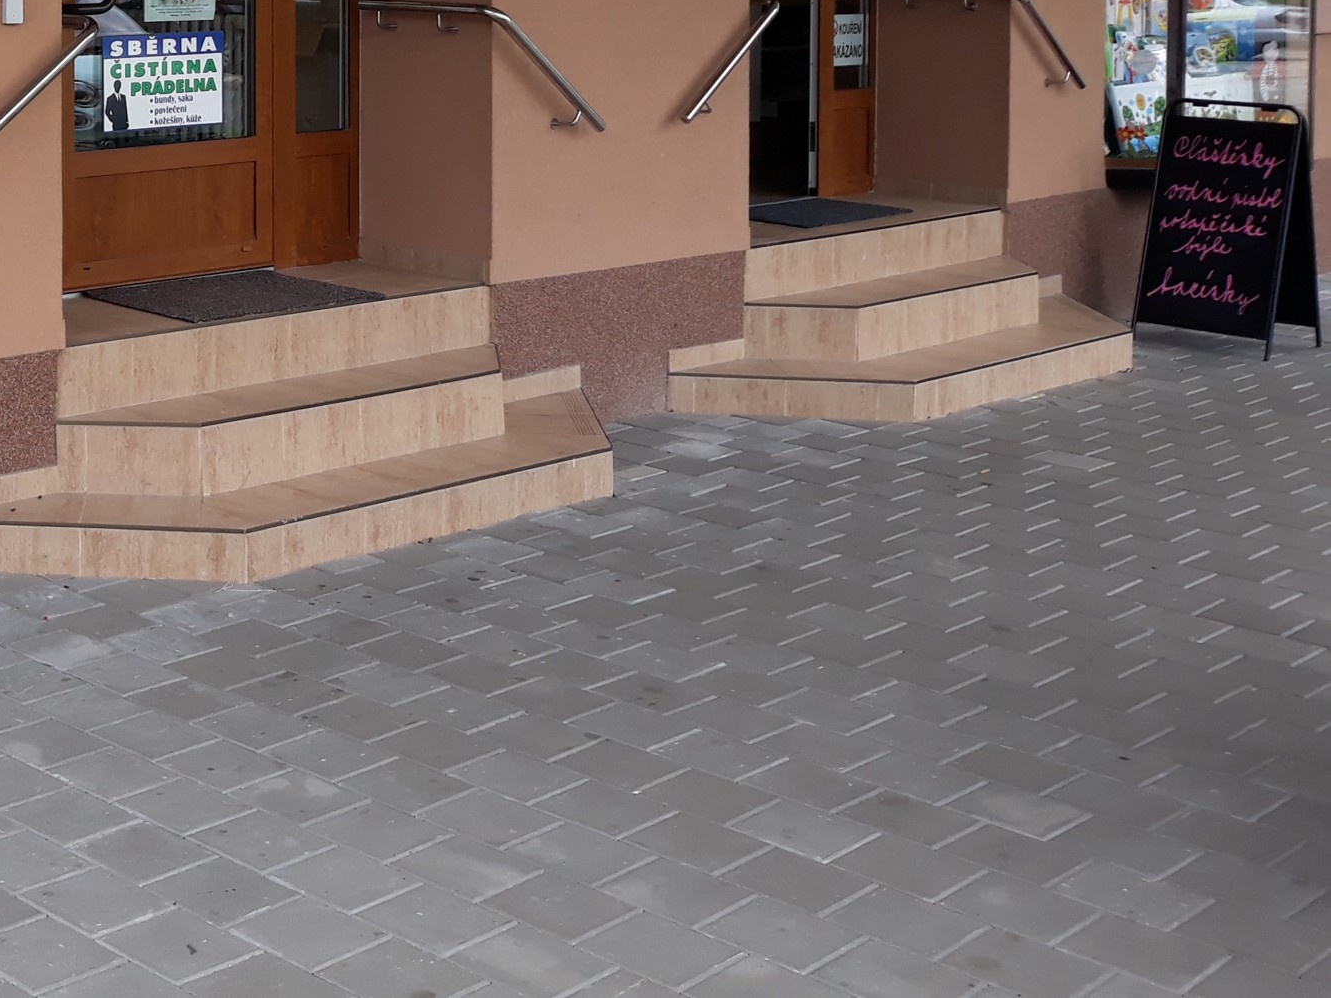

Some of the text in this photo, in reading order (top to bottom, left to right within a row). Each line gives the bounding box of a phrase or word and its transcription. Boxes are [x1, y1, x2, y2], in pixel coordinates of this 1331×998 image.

[838, 20, 862, 35] KOUŘENÍ
[109, 35, 218, 57] SBĚRNA
[832, 41, 863, 59] AKÁZÁNO
[110, 56, 218, 79] ČISTÍRNA
[130, 76, 218, 97] PRÁDELNA
[154, 93, 194, 105] bundy, saka
[186, 114, 202, 123] kůže
